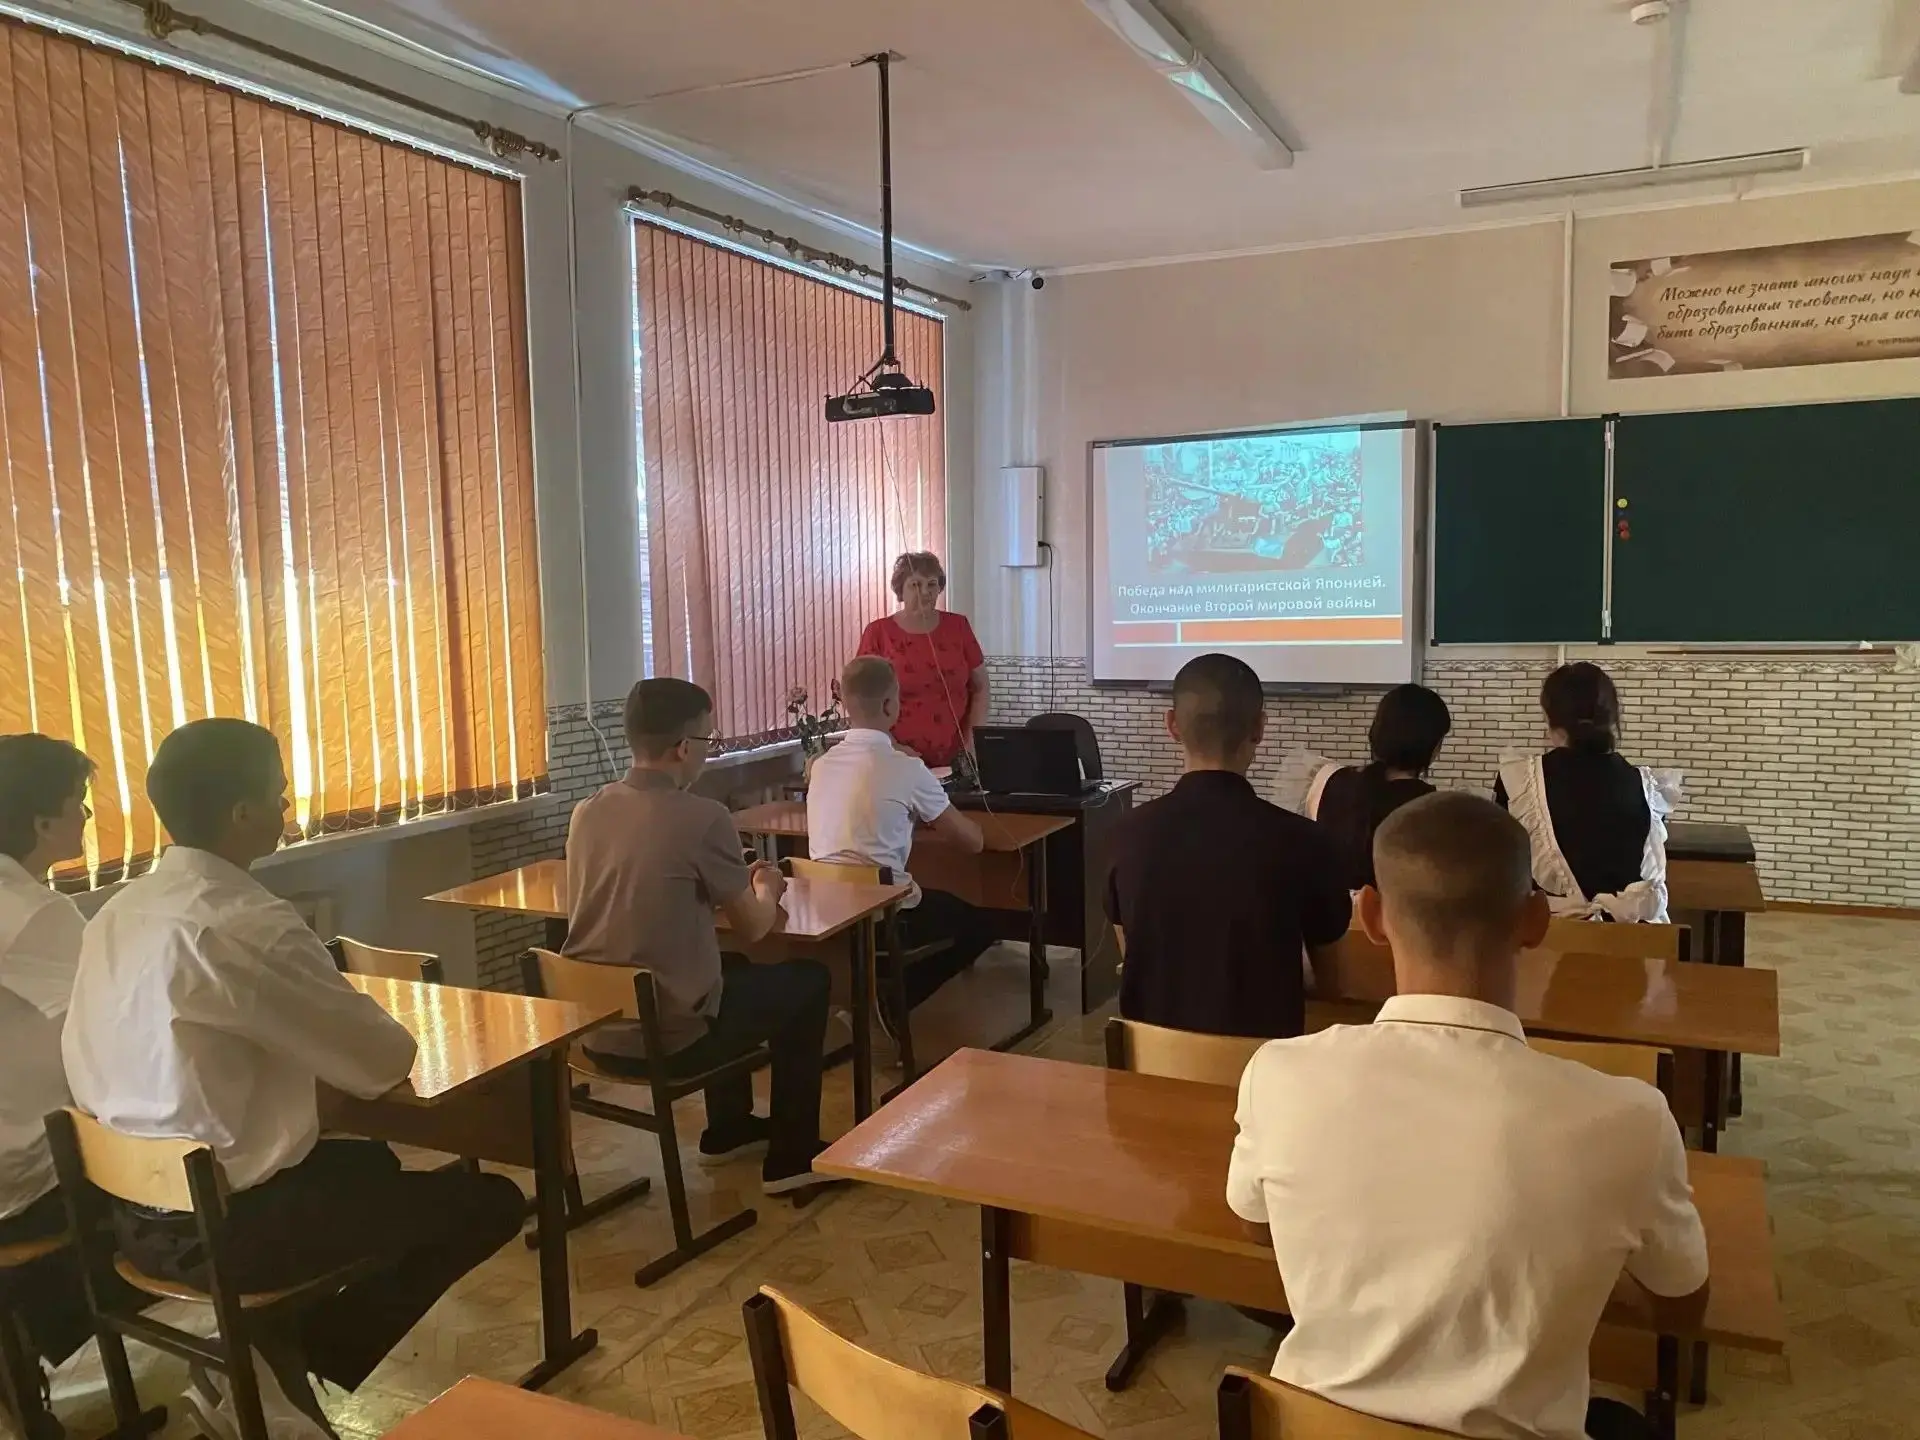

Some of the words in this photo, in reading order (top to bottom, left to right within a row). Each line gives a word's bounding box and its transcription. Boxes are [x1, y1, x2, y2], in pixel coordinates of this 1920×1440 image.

[1660, 287, 1721, 302] Можно
[1727, 284, 1746, 296] не
[1746, 280, 1798, 299] знать
[1804, 272, 1864, 289] многих
[1870, 268, 1911, 286] наук
[1667, 300, 1781, 323] образованным
[1788, 290, 1876, 309] человеком,
[1882, 290, 1905, 301] но
[1657, 325, 1693, 339] быть
[1698, 317, 1818, 341] образованным,
[1824, 315, 1845, 326] не
[1846, 312, 1889, 330] зная
[1118, 585, 1165, 598] Победа
[1169, 585, 1193, 597] над
[1196, 577, 1311, 597] милитаристской
[1315, 575, 1386, 590] Японией.
[1130, 602, 1201, 614] Окончание
[1205, 599, 1253, 614] Второй
[1258, 596, 1322, 612] мировой
[1327, 597, 1376, 609] войны
